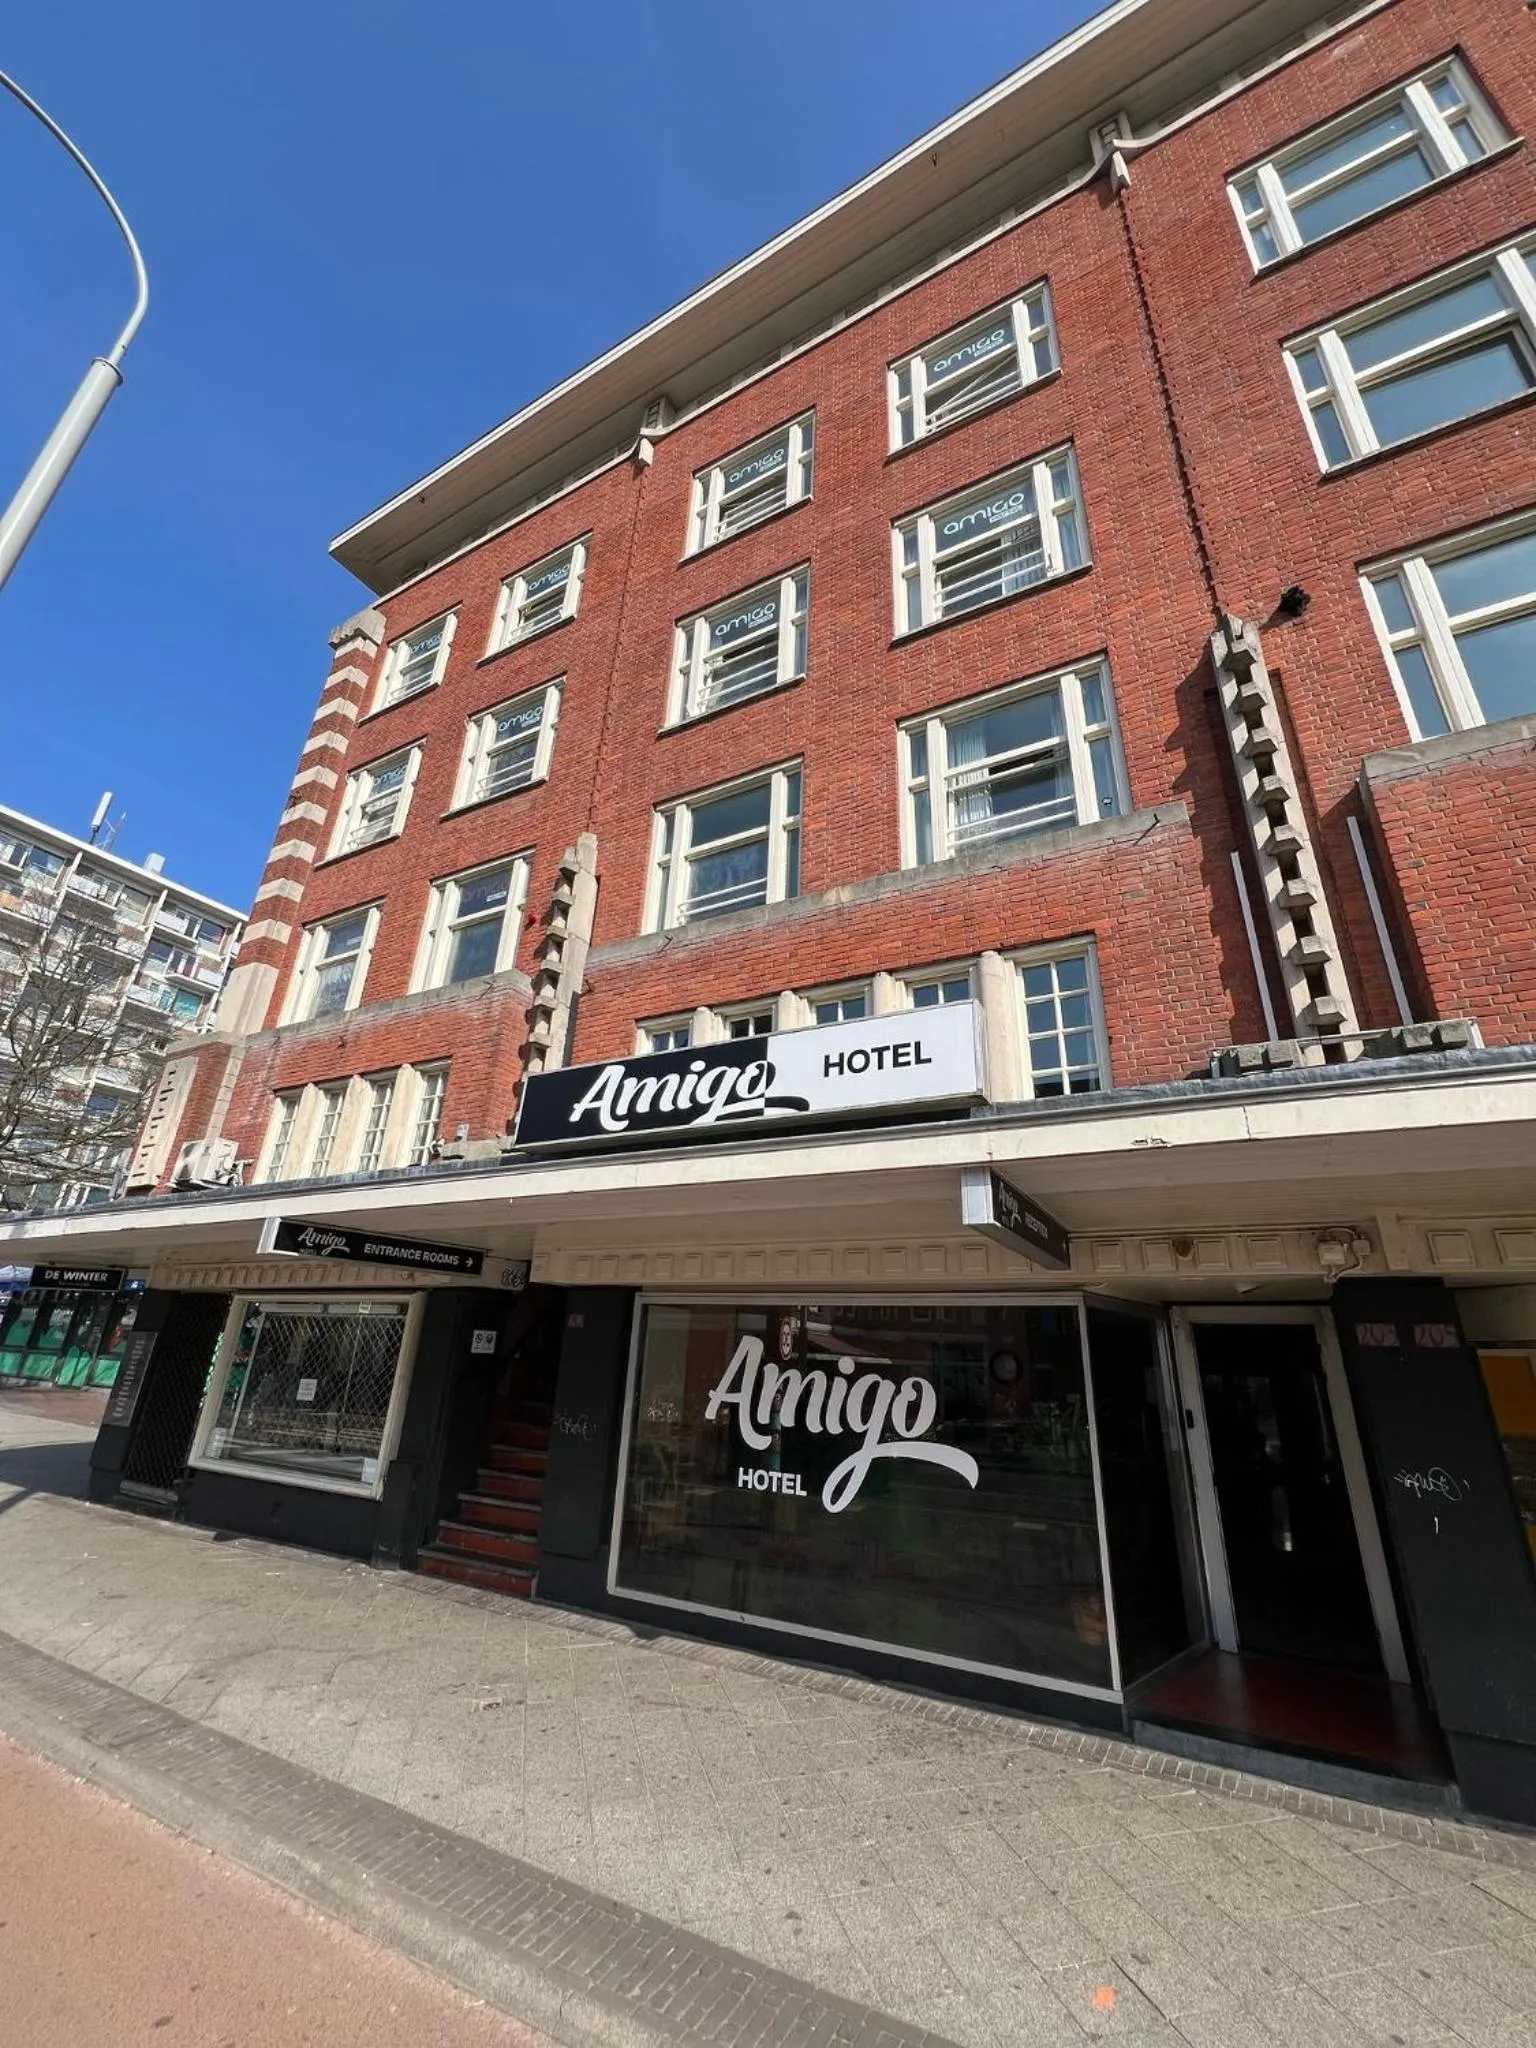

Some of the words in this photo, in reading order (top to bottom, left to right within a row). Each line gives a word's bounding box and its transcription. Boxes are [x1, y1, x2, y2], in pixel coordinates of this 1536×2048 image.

[569, 1059, 809, 1132] Amigo
[824, 1041, 933, 1078] HOTEL
[298, 1227, 350, 1256] Amigo
[364, 1243, 422, 1260] ENTRANCE
[423, 1251, 460, 1266] ROOMS
[45, 1270, 60, 1280] DE
[63, 1271, 109, 1282] WINTER
[704, 1335, 979, 1514] Amigo
[737, 1467, 808, 1497] HOTEL
